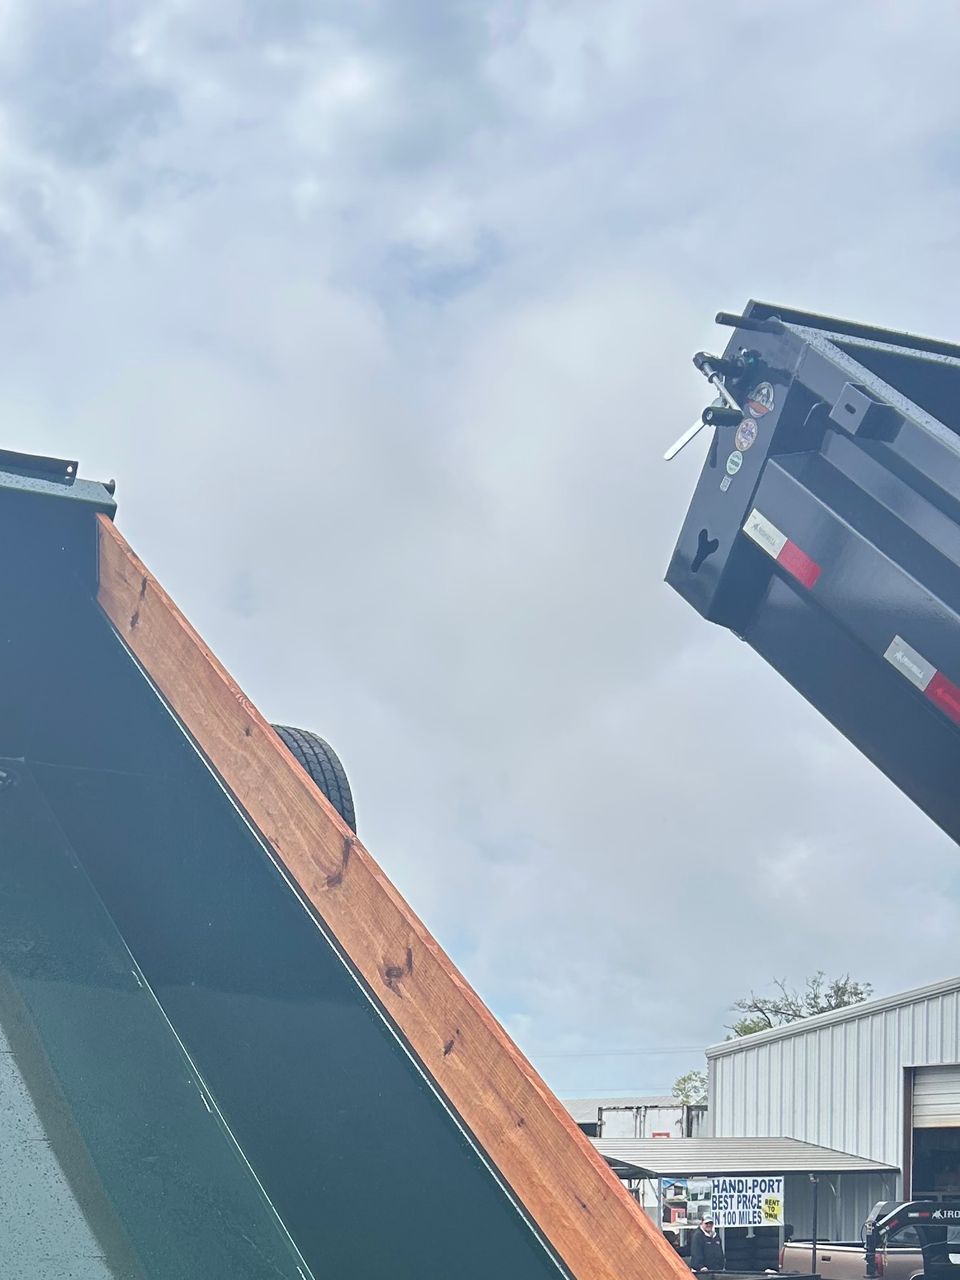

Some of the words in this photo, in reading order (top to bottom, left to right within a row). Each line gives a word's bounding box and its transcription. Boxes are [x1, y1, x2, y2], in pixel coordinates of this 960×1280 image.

[712, 1179, 782, 1194] HANDI-PORT
[711, 1195, 734, 1210] BEST
[737, 1194, 762, 1210] PRICE
[712, 1211, 720, 1225] IN
[723, 1211, 736, 1225] 100
[739, 1211, 762, 1225] MILES
